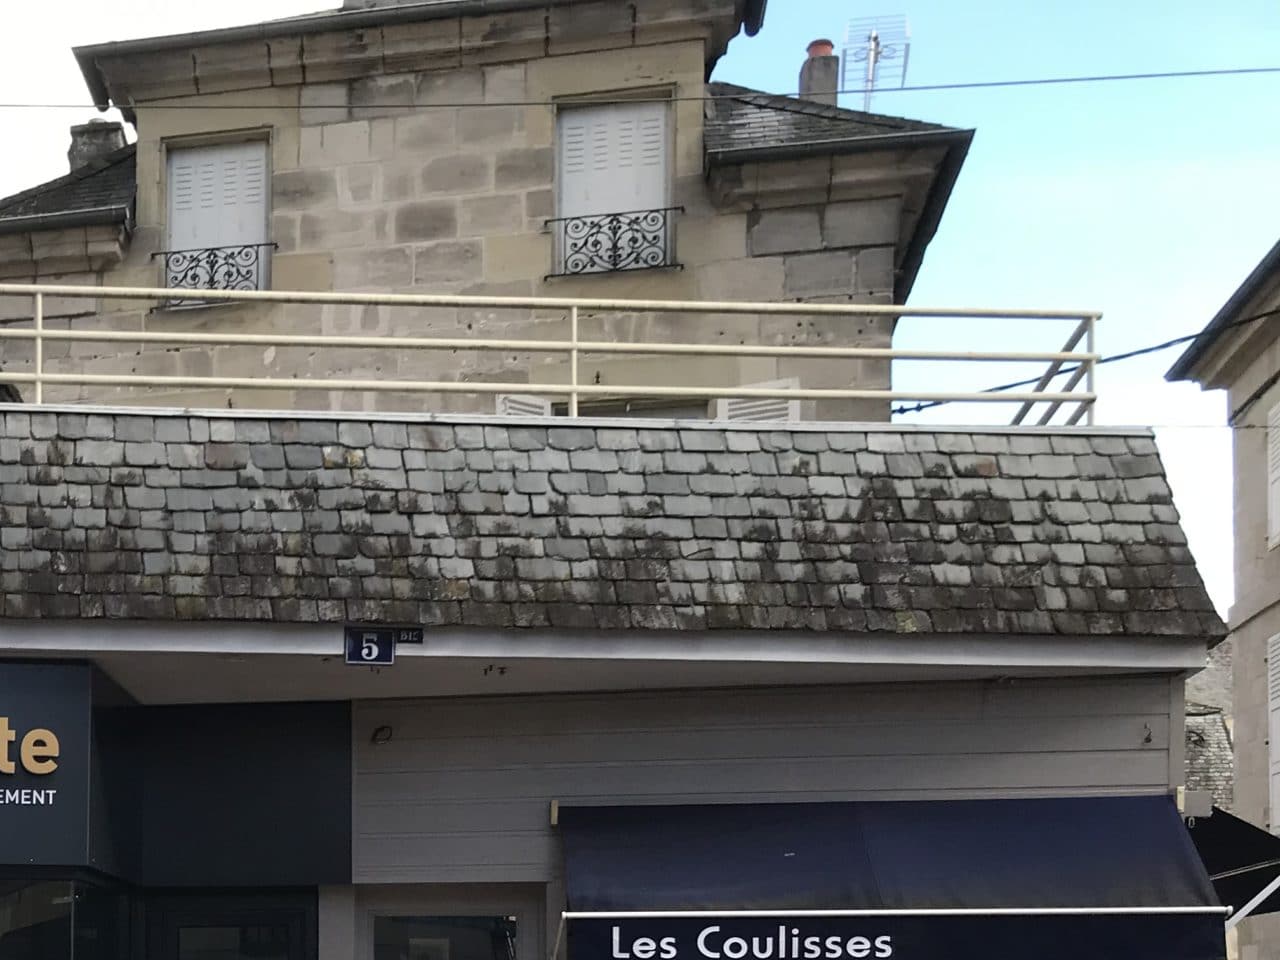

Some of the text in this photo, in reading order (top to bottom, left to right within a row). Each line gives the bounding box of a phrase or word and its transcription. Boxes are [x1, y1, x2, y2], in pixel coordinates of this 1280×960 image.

[361, 633, 379, 660] 5
[612, 925, 893, 959] Les Coulisses
